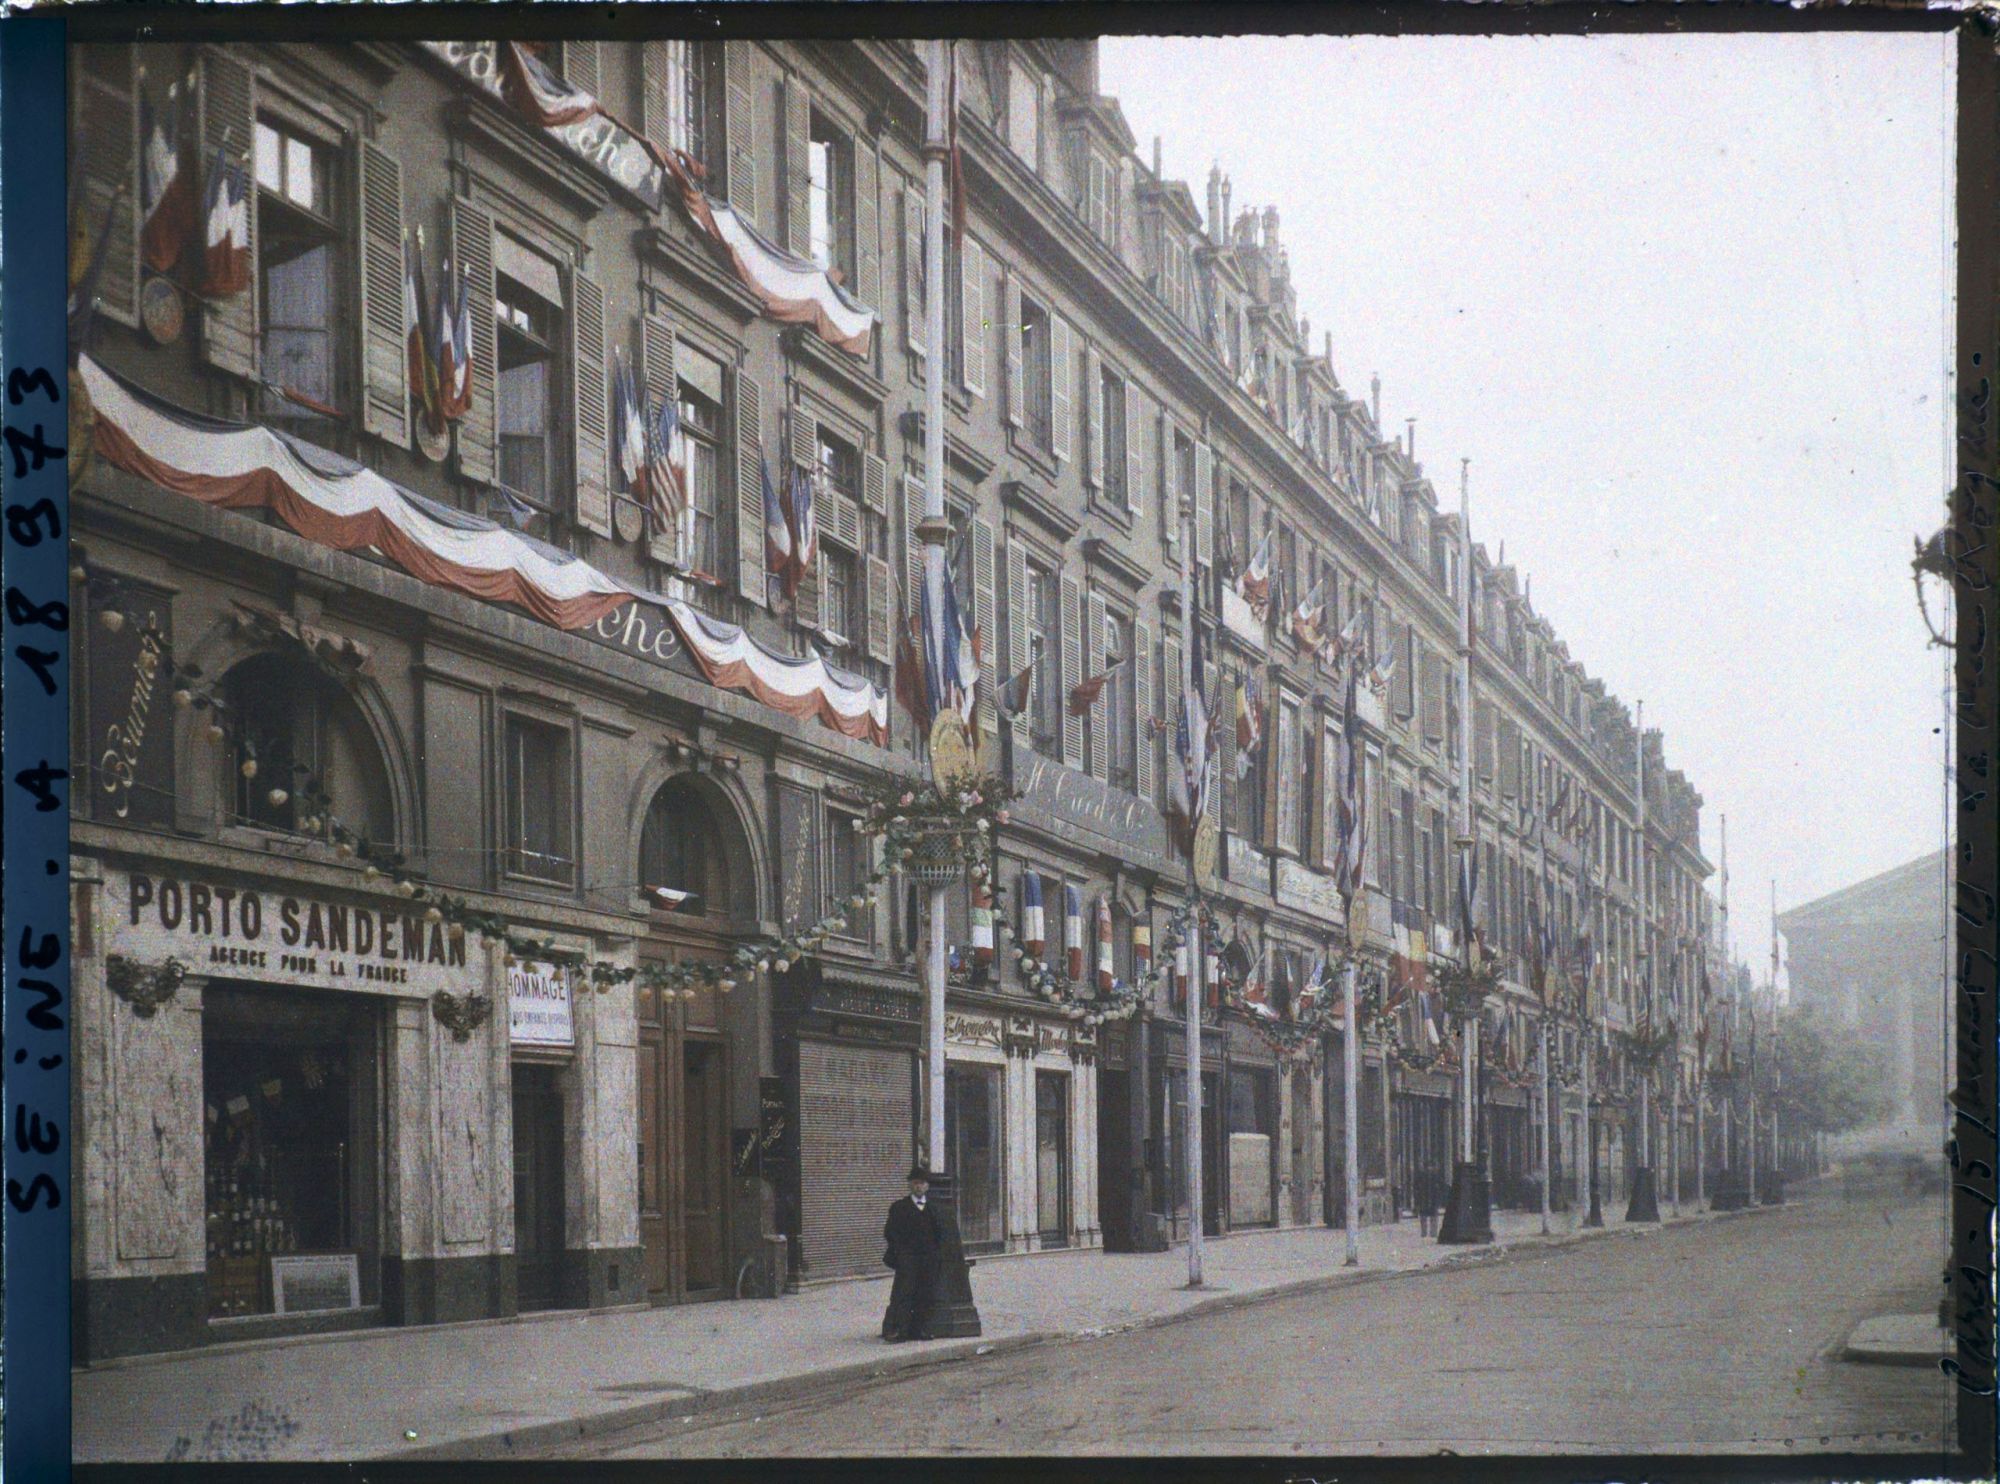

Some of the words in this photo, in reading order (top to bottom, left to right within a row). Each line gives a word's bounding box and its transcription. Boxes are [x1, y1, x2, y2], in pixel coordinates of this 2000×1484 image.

[584, 602, 682, 660] che
[14, 758, 70, 812] A
[129, 874, 262, 941] PORTO
[280, 898, 467, 968] SANDEMAN
[210, 945, 267, 969] AGENCE
[281, 954, 316, 974] POUR
[330, 960, 345, 976] LA
[358, 963, 408, 984] FRANCE
[508, 973, 566, 1001] HOMMAGE
